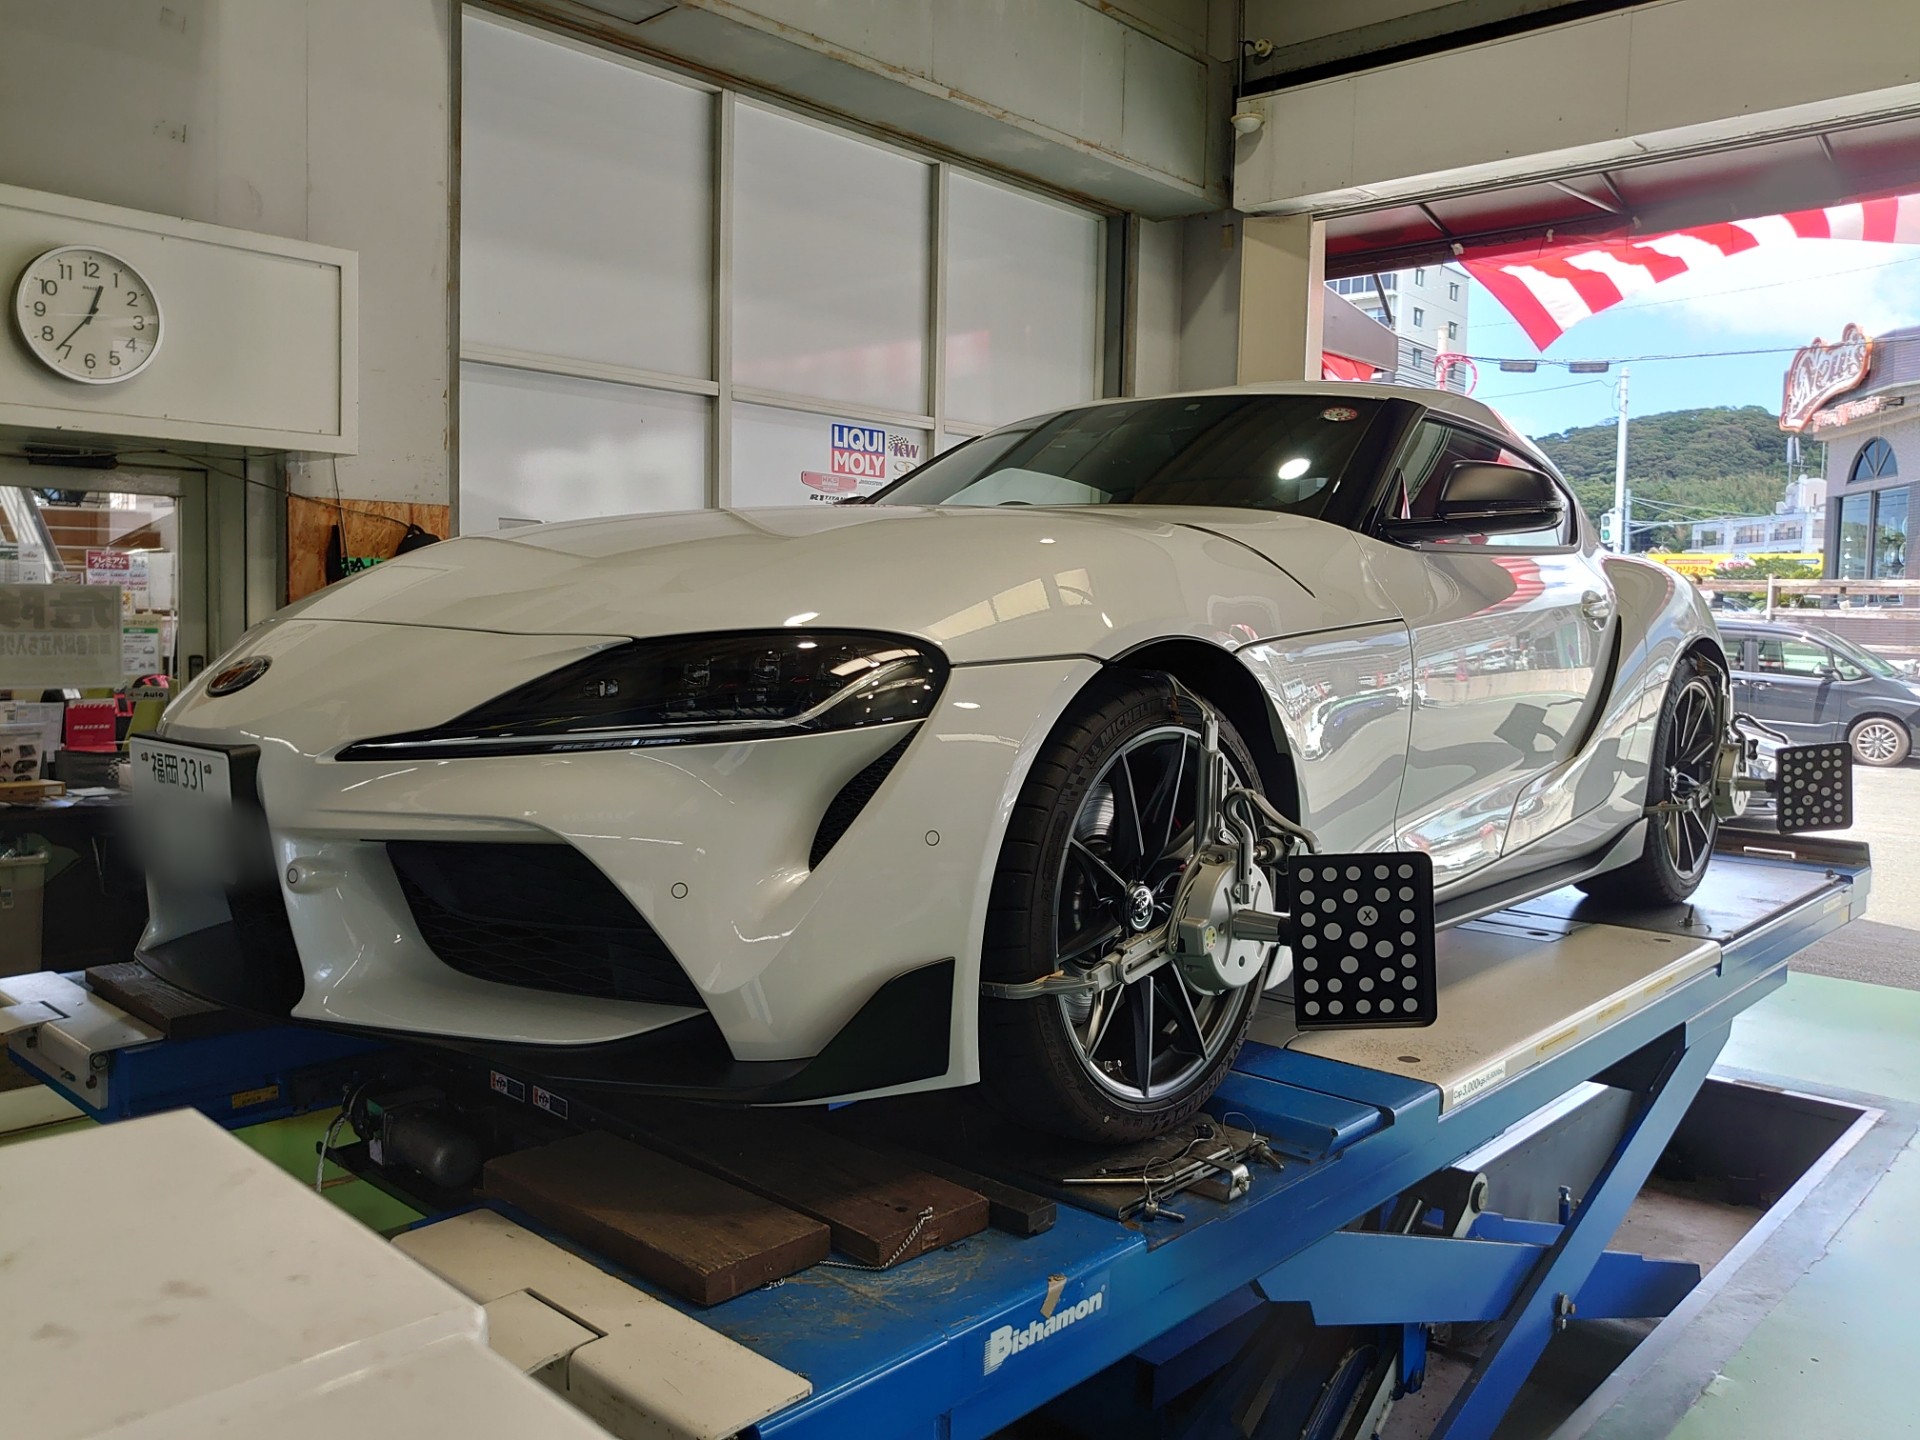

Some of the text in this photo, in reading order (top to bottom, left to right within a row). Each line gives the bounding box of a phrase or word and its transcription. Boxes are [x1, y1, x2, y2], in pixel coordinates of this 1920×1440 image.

[59, 263, 73, 281] 11
[83, 261, 100, 279] 12
[39, 278, 58, 296] 10
[113, 272, 119, 289] 1
[126, 291, 138, 307] 2
[33, 301, 46, 317] 9
[132, 315, 145, 331] 3
[41, 325, 54, 341] 8
[61, 342, 72, 360] 7
[125, 337, 138, 352] 4
[84, 353, 96, 369] 6
[109, 350, 121, 366] 5
[834, 425, 883, 453] LIQUI
[893, 442, 919, 459] KW
[833, 450, 885, 477] MOLY
[822, 475, 838, 484] HKS
[1100, 697, 1161, 747] MICHELI
[984, 1290, 1104, 1377] Bishamon
